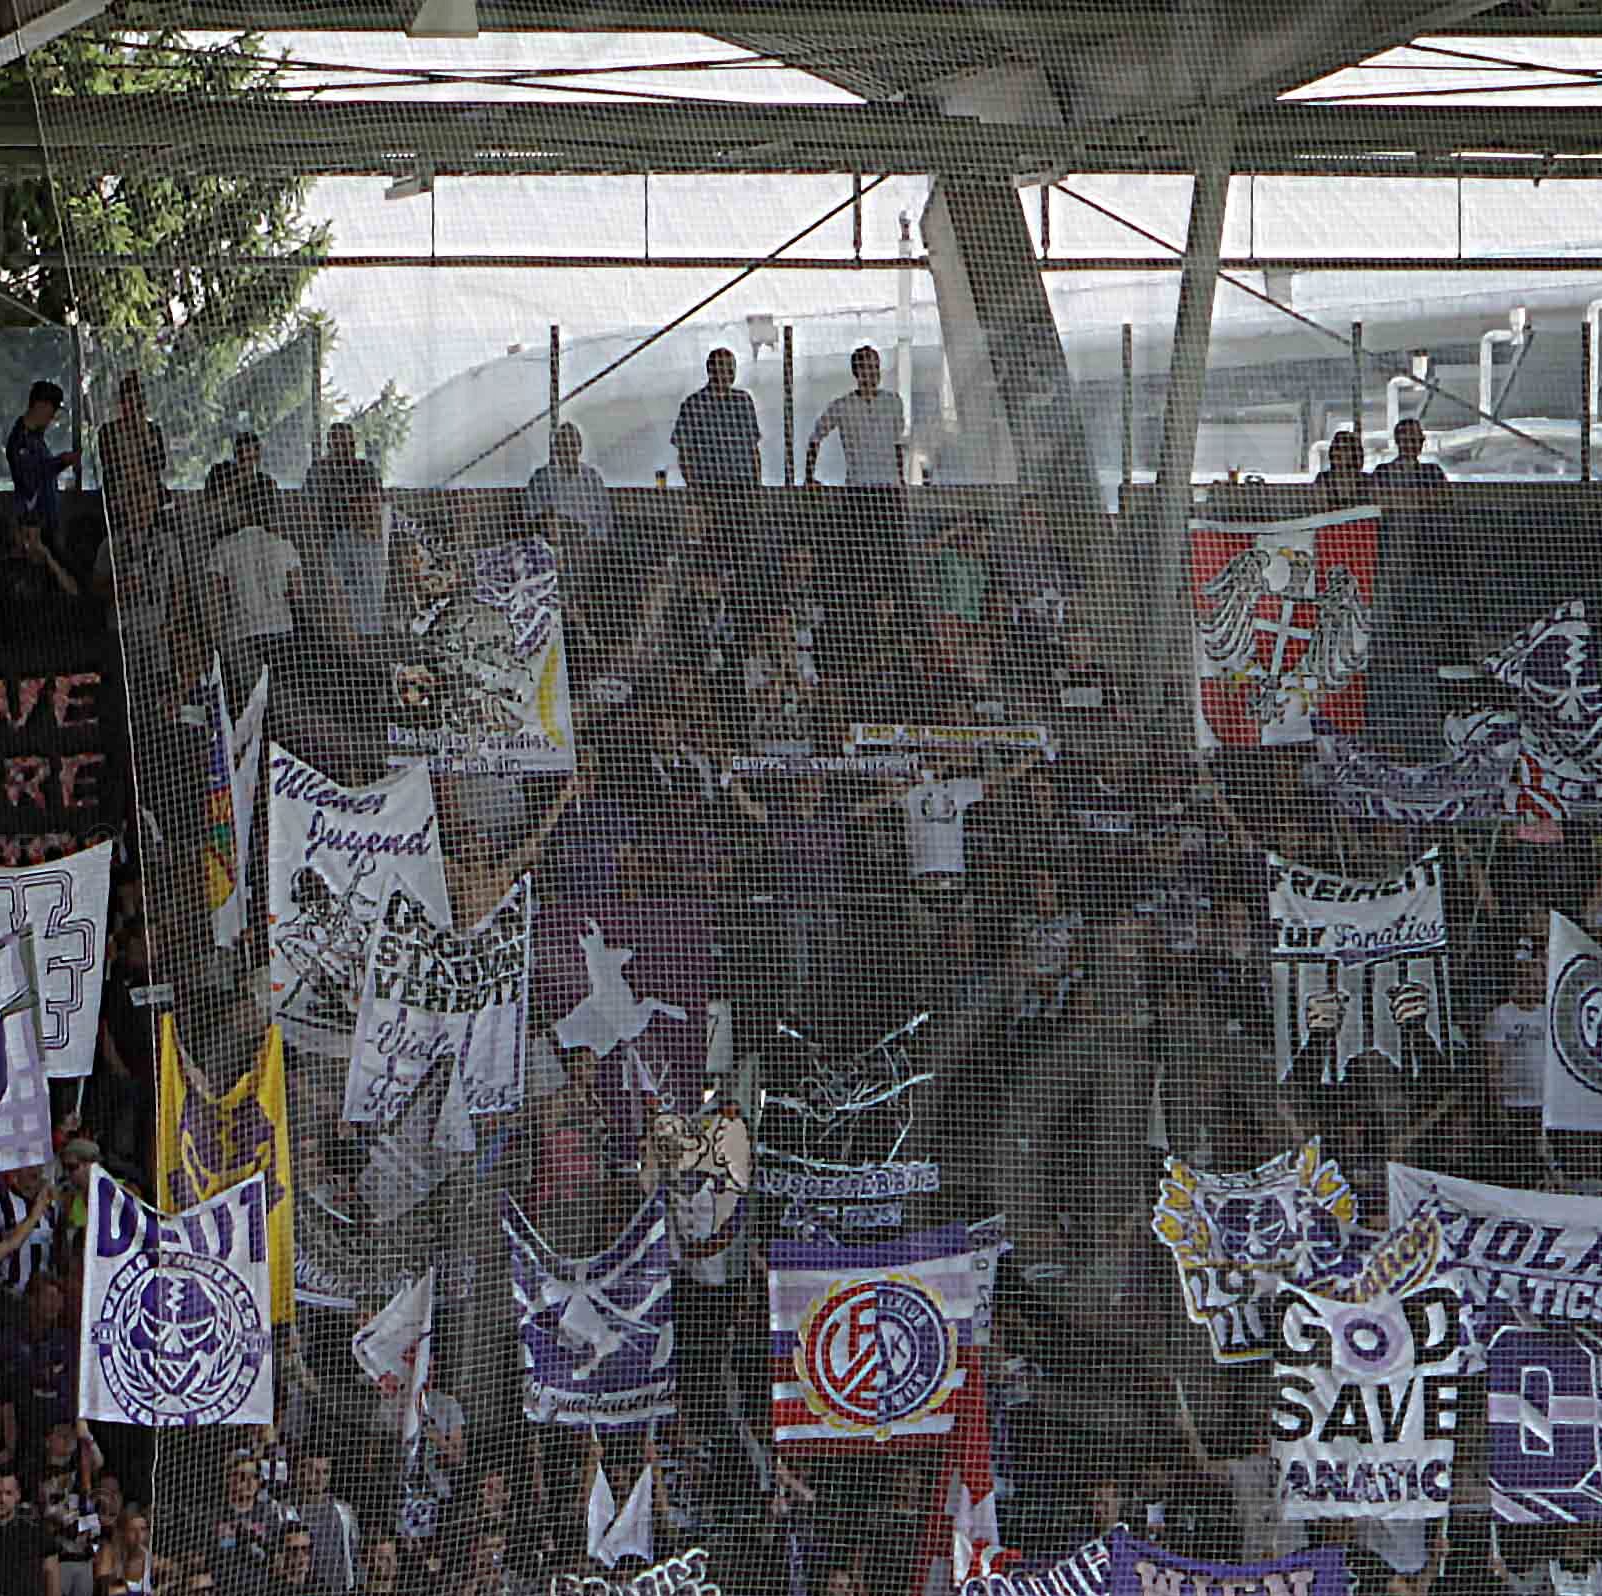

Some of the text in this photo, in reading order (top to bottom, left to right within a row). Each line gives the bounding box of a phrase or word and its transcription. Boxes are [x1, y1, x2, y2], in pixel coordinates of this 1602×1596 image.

[308, 813, 434, 861] Jugend
[1277, 1292, 1462, 1366] GOD
[1273, 1376, 1459, 1443] SAVE
